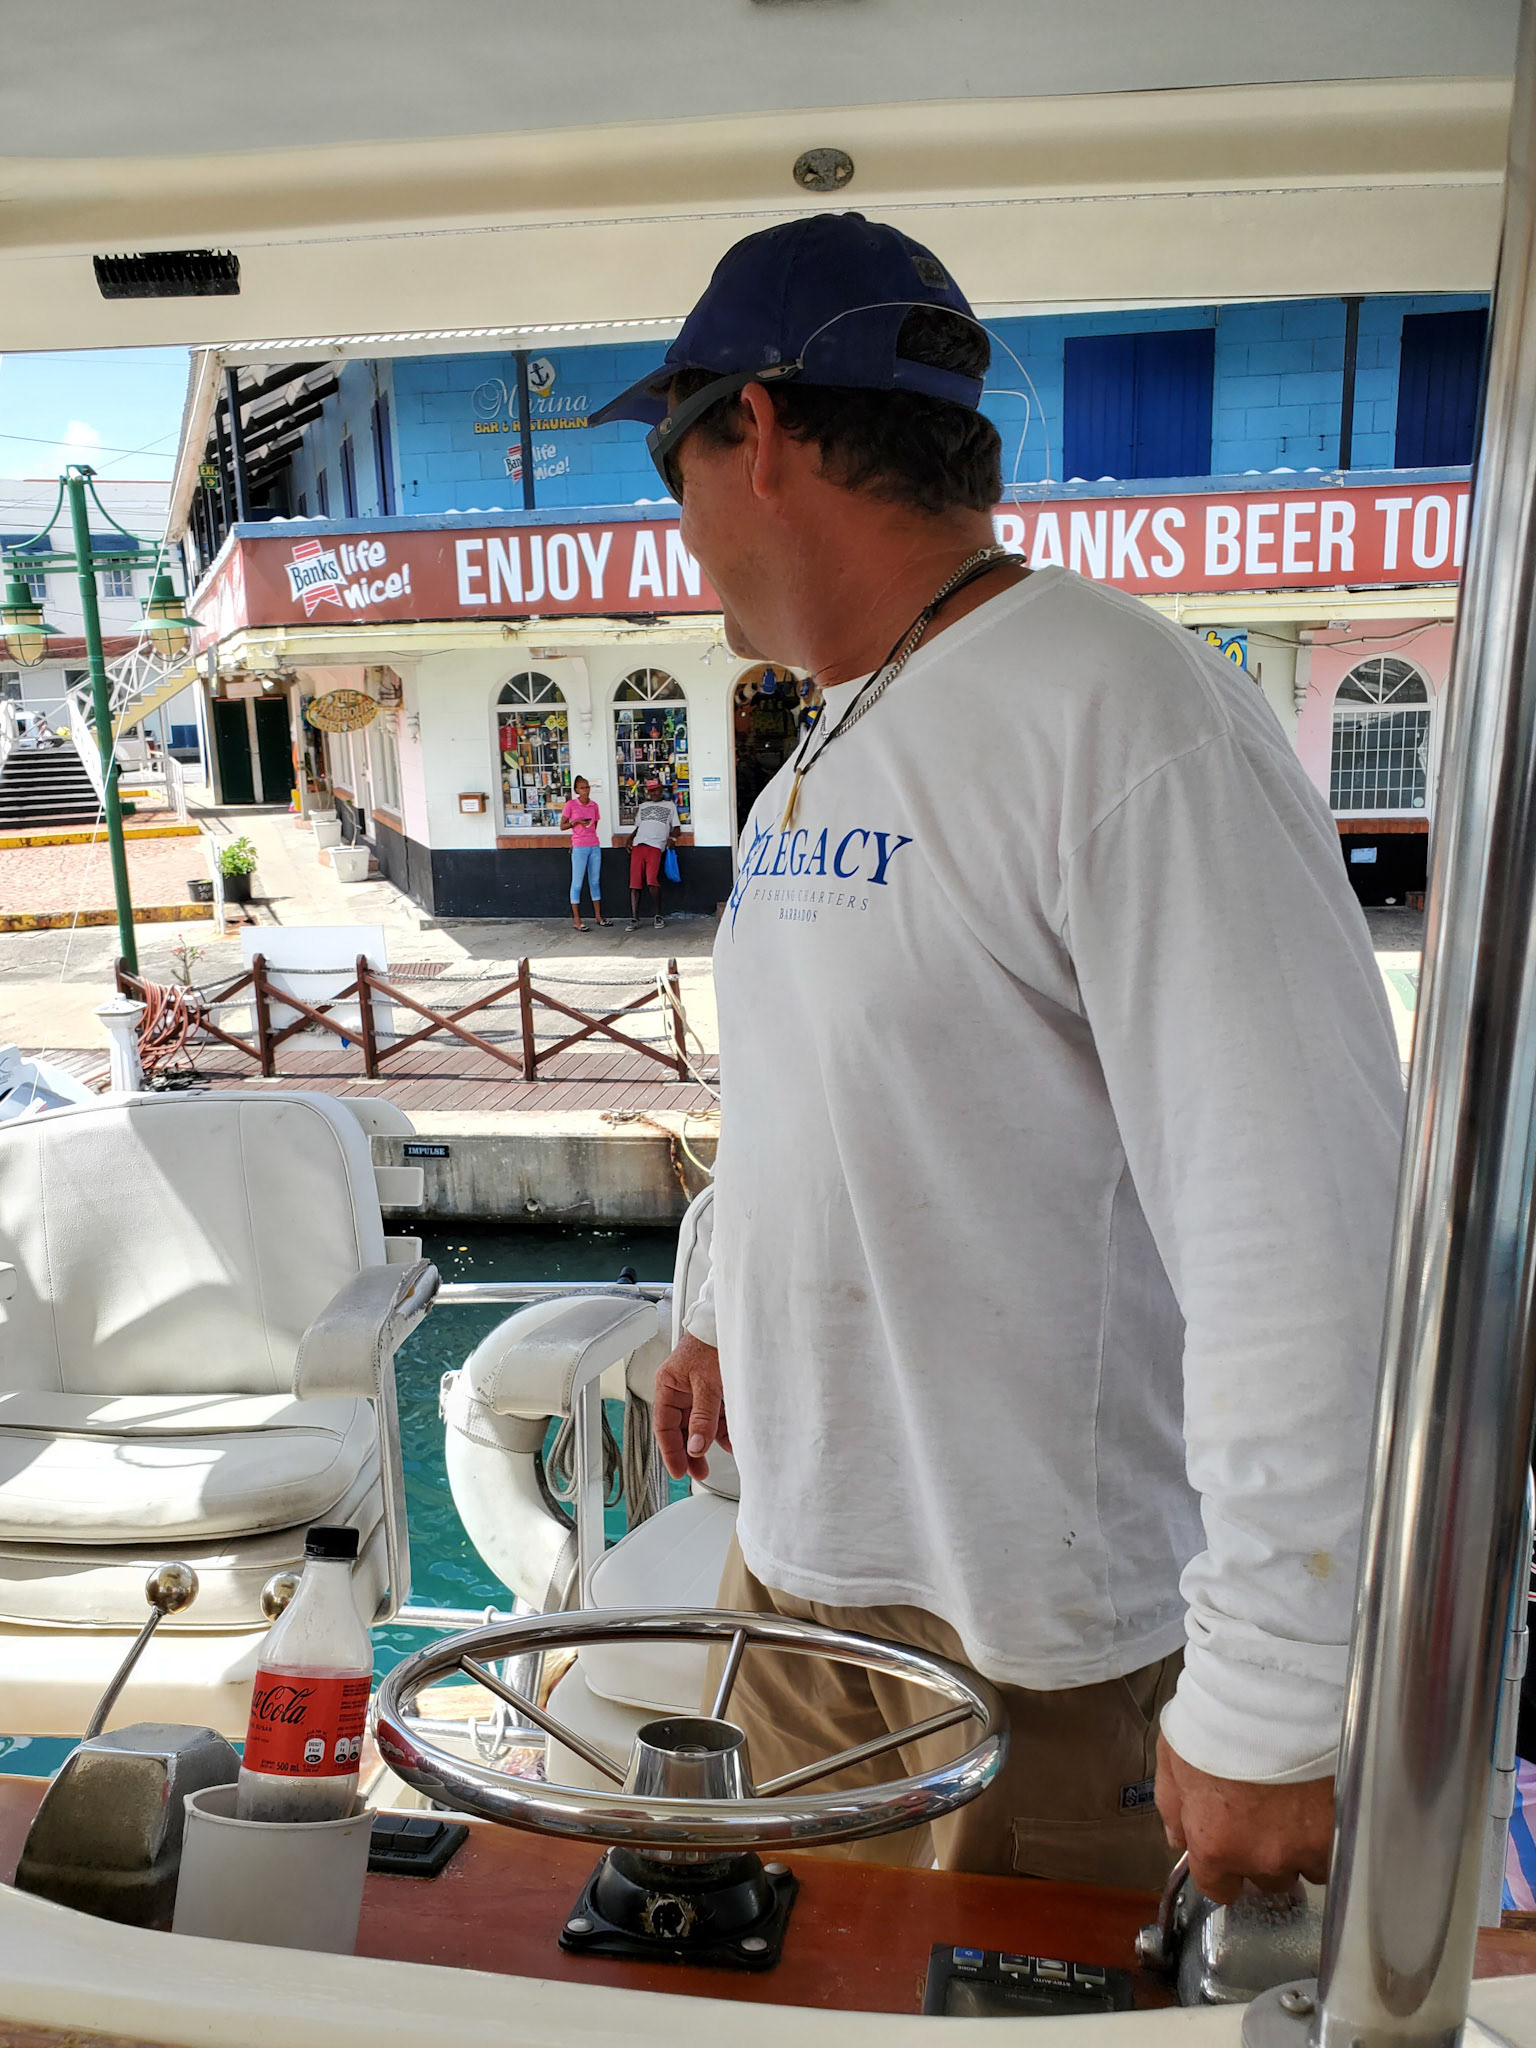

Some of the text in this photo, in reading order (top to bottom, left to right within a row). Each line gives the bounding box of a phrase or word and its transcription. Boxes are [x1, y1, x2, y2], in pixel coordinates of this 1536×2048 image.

[472, 378, 591, 419] Mrina
[474, 422, 499, 434] BAR
[512, 416, 588, 432] RSTAURAN
[532, 443, 557, 462] life
[505, 458, 522, 472] Ban
[339, 540, 387, 575] life
[455, 531, 614, 606] ENJOY
[1204, 500, 1356, 577] BEER
[290, 559, 338, 592] Banks
[343, 563, 412, 609] nice!
[333, 692, 355, 704] THE
[752, 827, 914, 886] LEGACY
[753, 889, 869, 911] FISHING CHARTERS
[779, 907, 819, 922] BARBADOS
[408, 1147, 446, 1155] IMPULSE
[276, 1762, 289, 1771] 500
